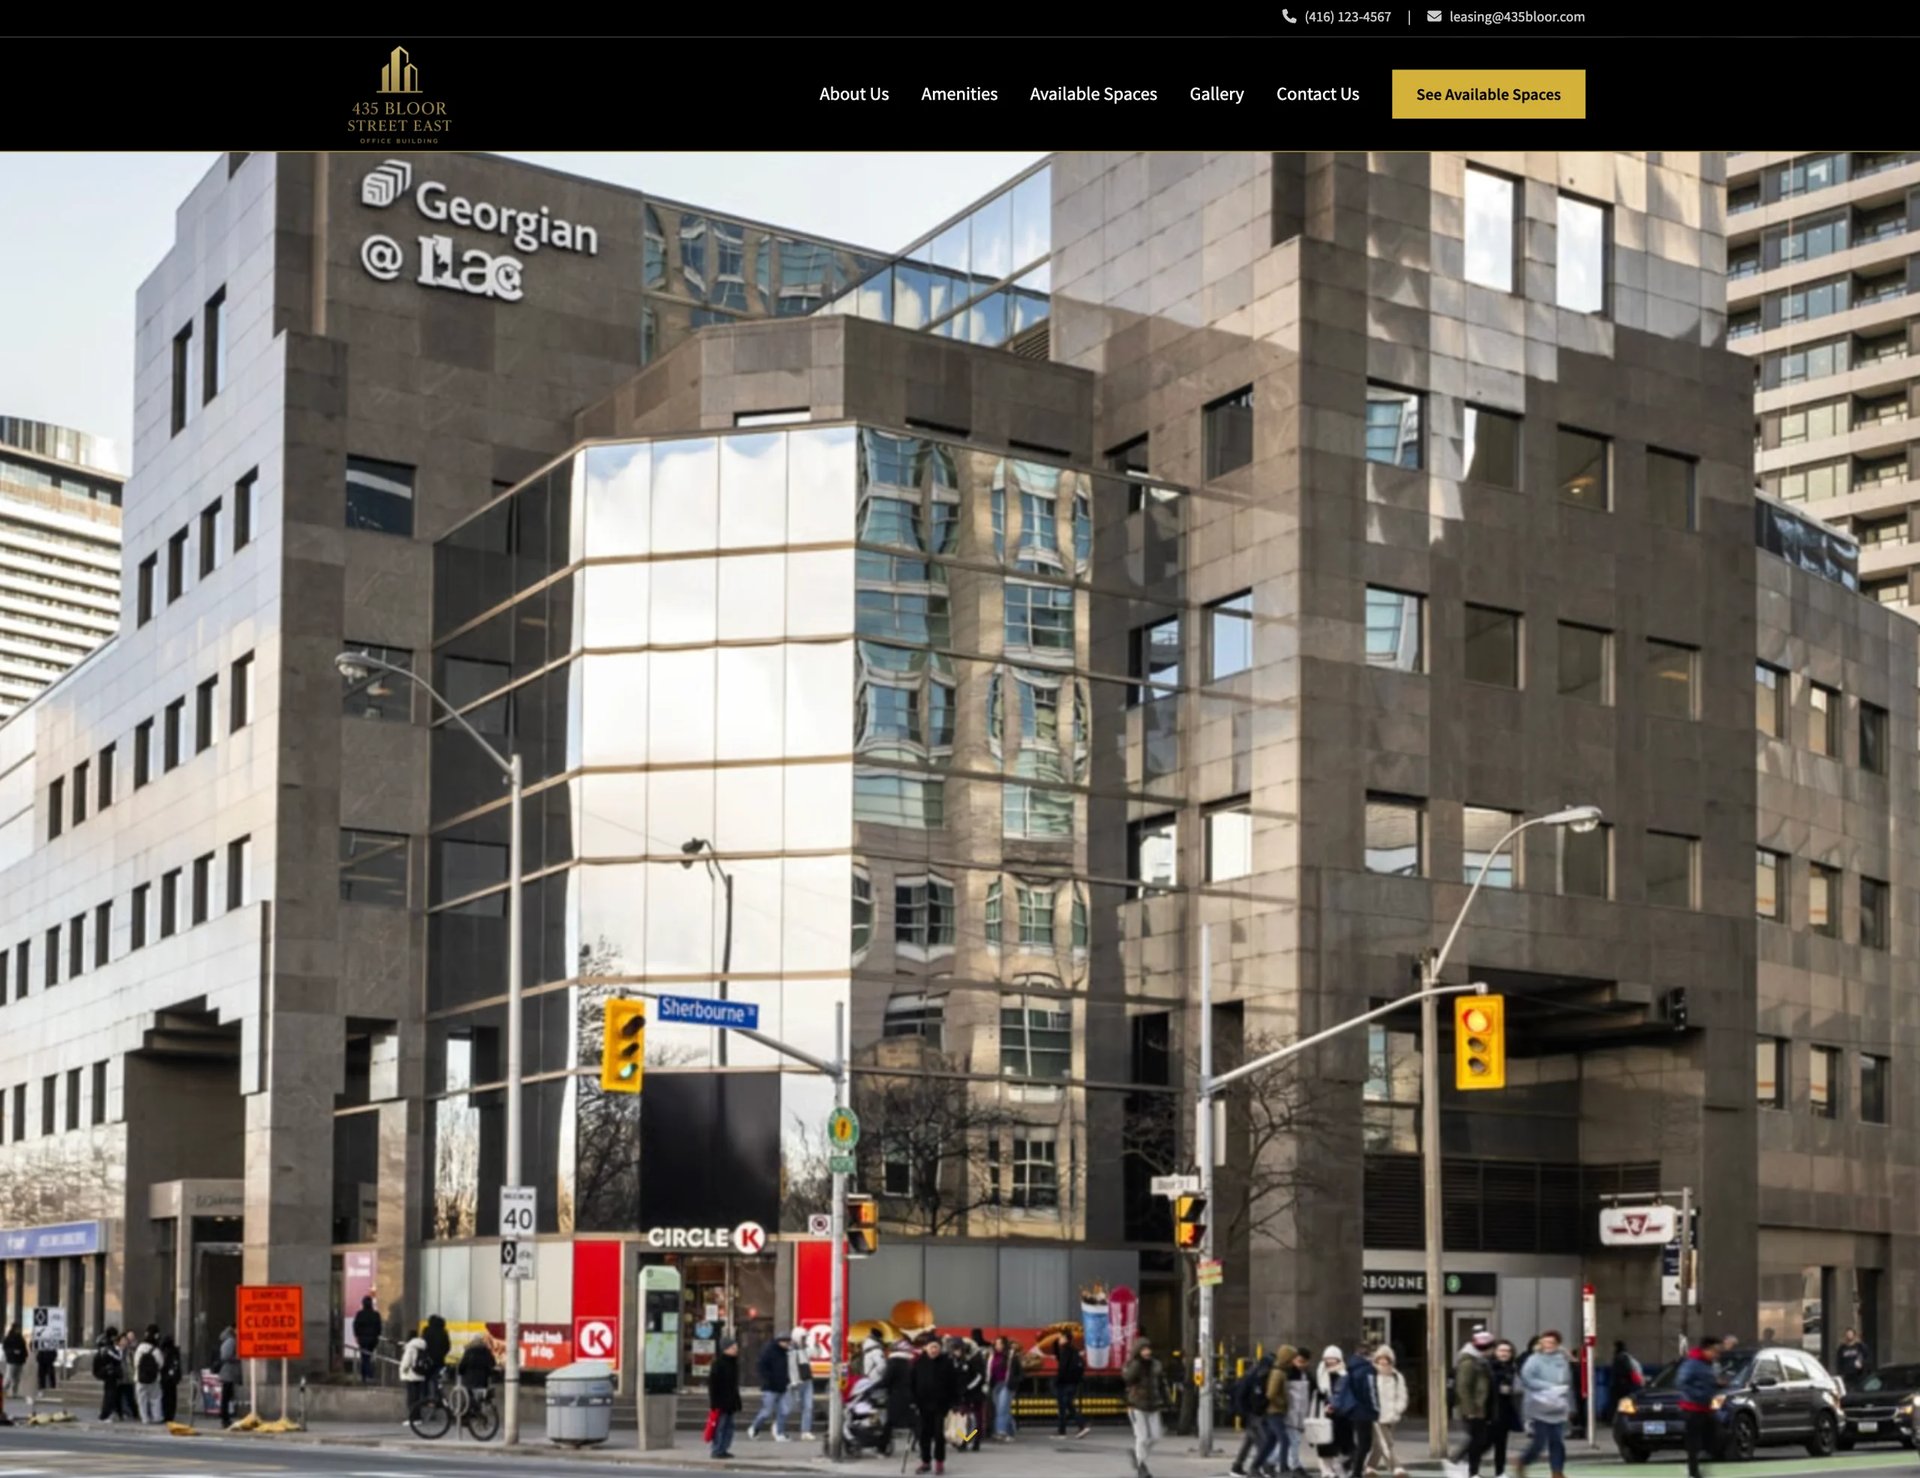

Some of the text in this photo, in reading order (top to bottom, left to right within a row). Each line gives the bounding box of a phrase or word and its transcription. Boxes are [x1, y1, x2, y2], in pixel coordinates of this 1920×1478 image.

[416, 180, 598, 254] Georgian
[361, 234, 403, 280] @
[662, 997, 744, 1023] Sherbourne
[504, 1208, 533, 1230] 40
[648, 1227, 729, 1247] CIRCLE
[245, 1315, 296, 1328] CLOSED
